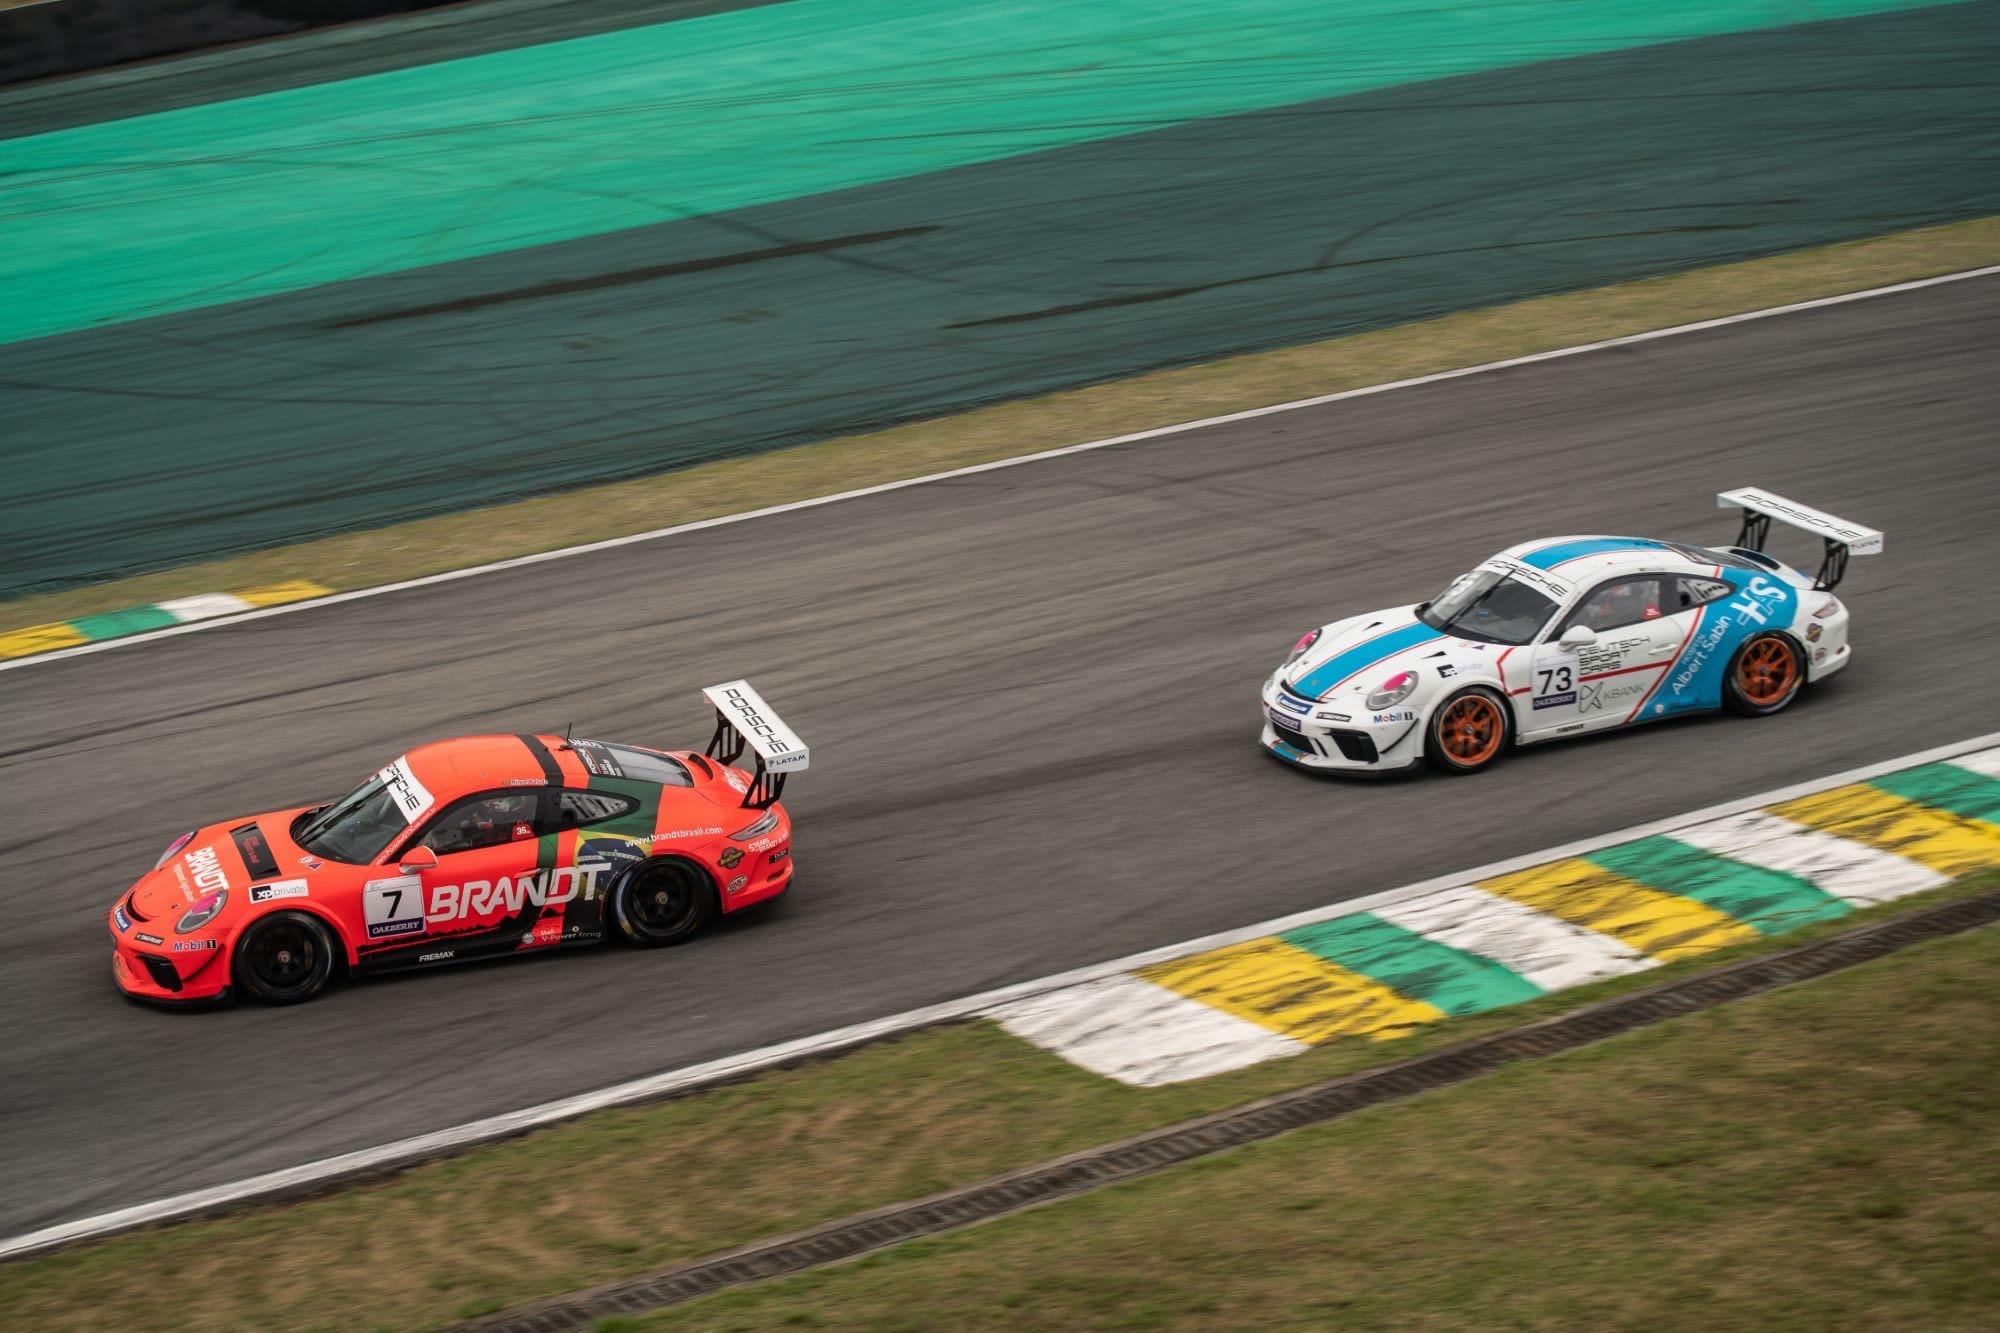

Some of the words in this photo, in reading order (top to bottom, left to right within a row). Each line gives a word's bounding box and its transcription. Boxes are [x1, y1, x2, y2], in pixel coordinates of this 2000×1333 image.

[1740, 494, 1863, 538] PORSCHE
[1579, 649, 1630, 666] SPORT
[1672, 651, 1708, 695] Albert
[1703, 616, 1732, 652] Sabin
[1580, 661, 1621, 676] CARS
[1538, 667, 1571, 694] 73
[721, 688, 790, 754] PORSCHE
[1374, 713, 1402, 723] Mobil
[776, 755, 806, 765] LATAM
[625, 826, 723, 848] www.brandtbrasil.com
[184, 846, 229, 896] BRANDT
[273, 885, 306, 897] private
[425, 862, 612, 923] BRANDT
[382, 890, 402, 919] 7
[372, 921, 419, 934] OAKBERRY
[541, 932, 577, 942] V-Power
[578, 931, 601, 939] Racing
[174, 940, 203, 951] Mobil
[419, 951, 454, 962] FREMAX
